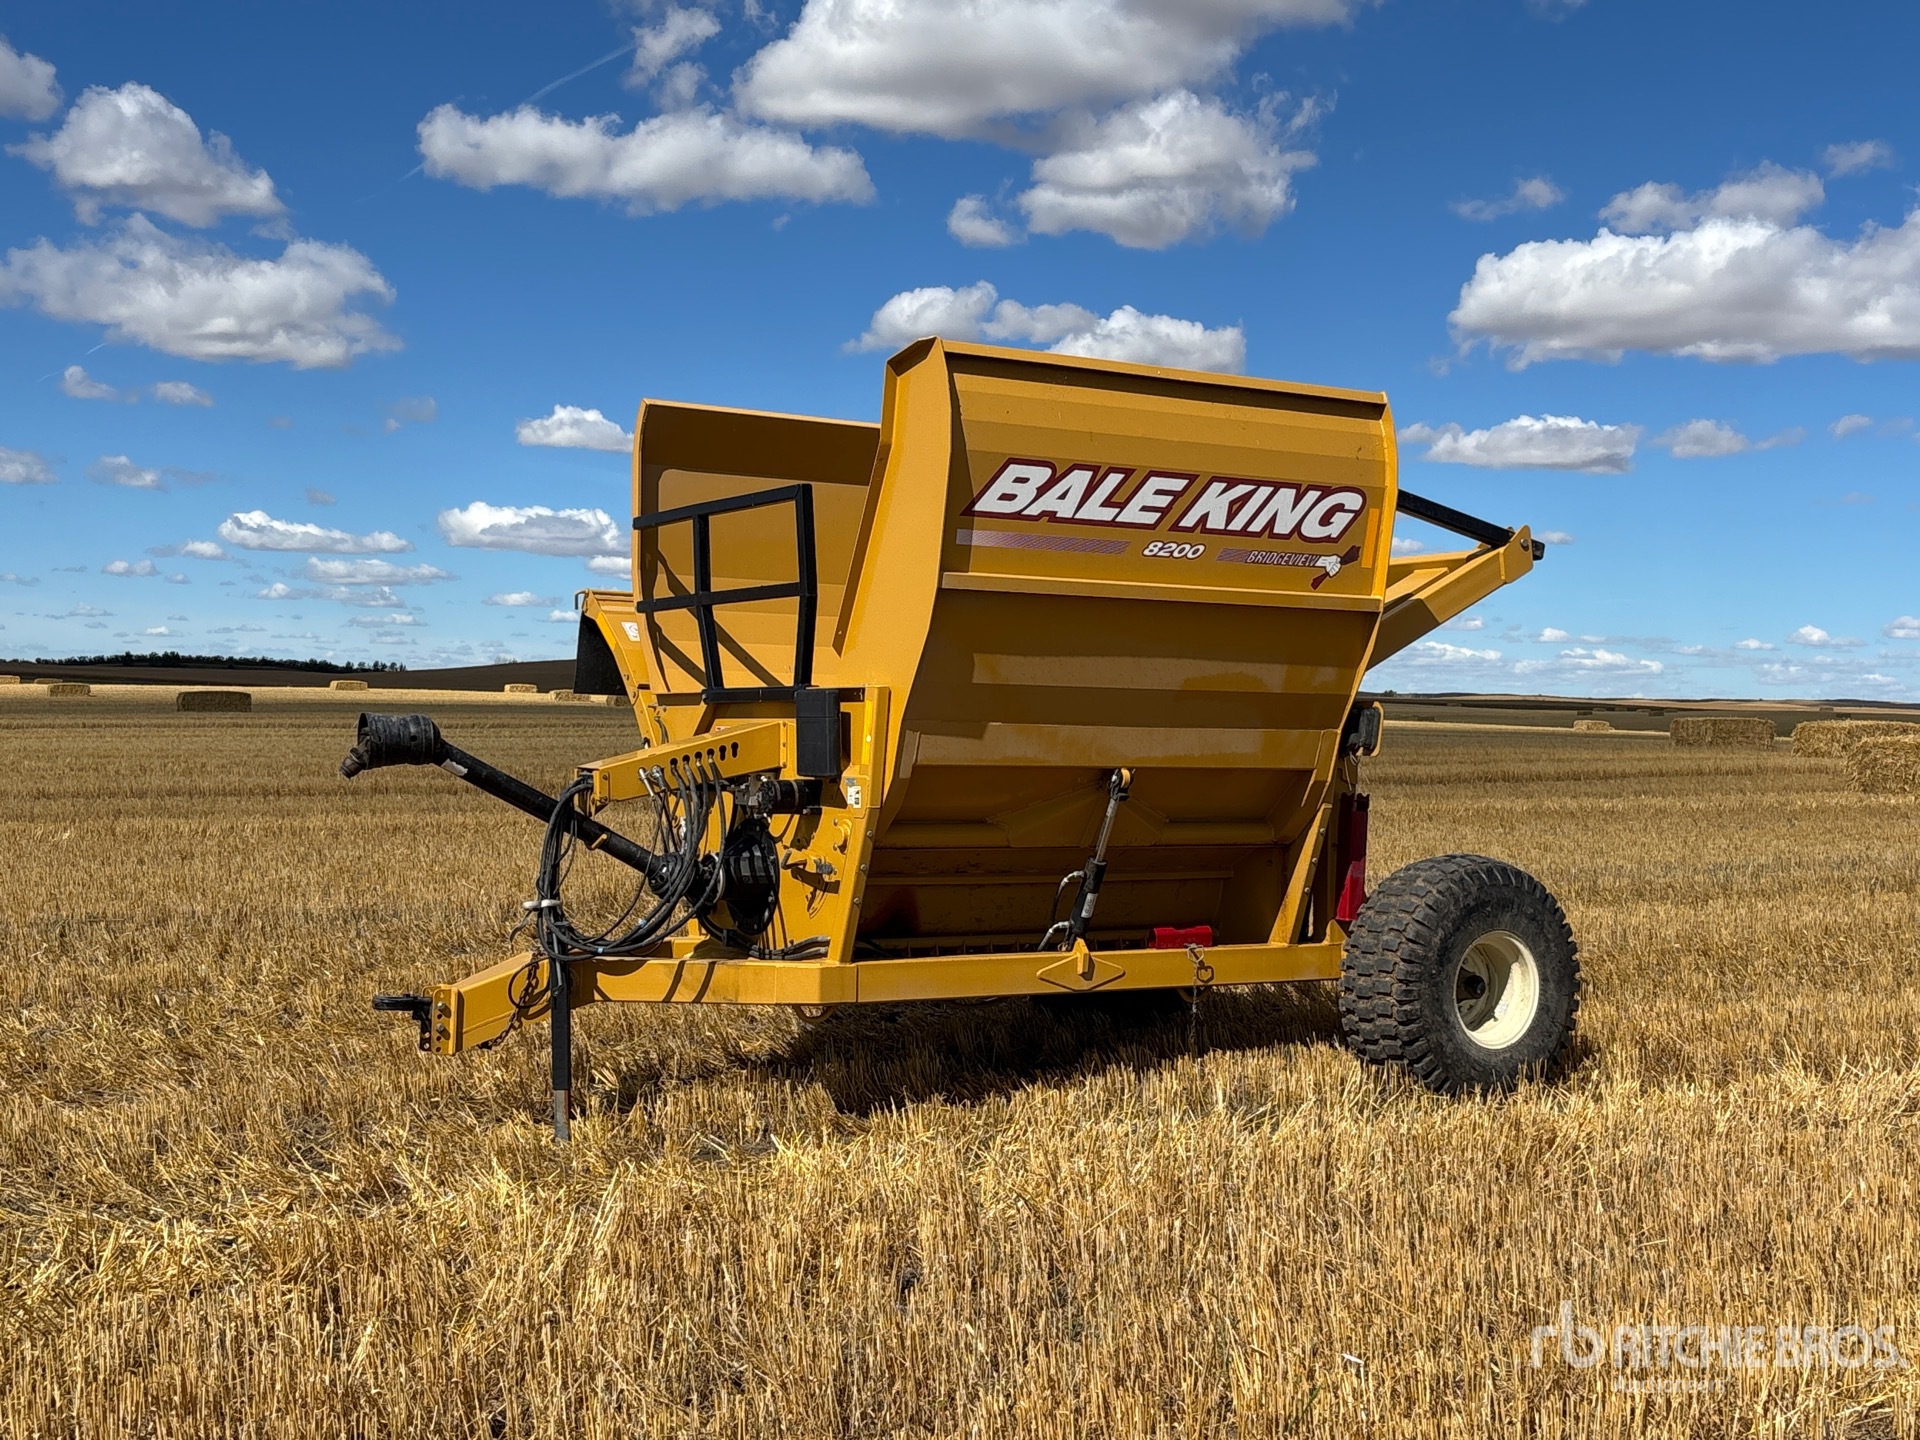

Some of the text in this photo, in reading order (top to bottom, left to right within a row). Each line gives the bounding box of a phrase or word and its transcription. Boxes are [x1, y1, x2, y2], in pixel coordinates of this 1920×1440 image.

[972, 463, 1363, 539] BALE KING
[1143, 541, 1206, 559] 8200
[1246, 550, 1321, 567] BRIDGEVIEW
